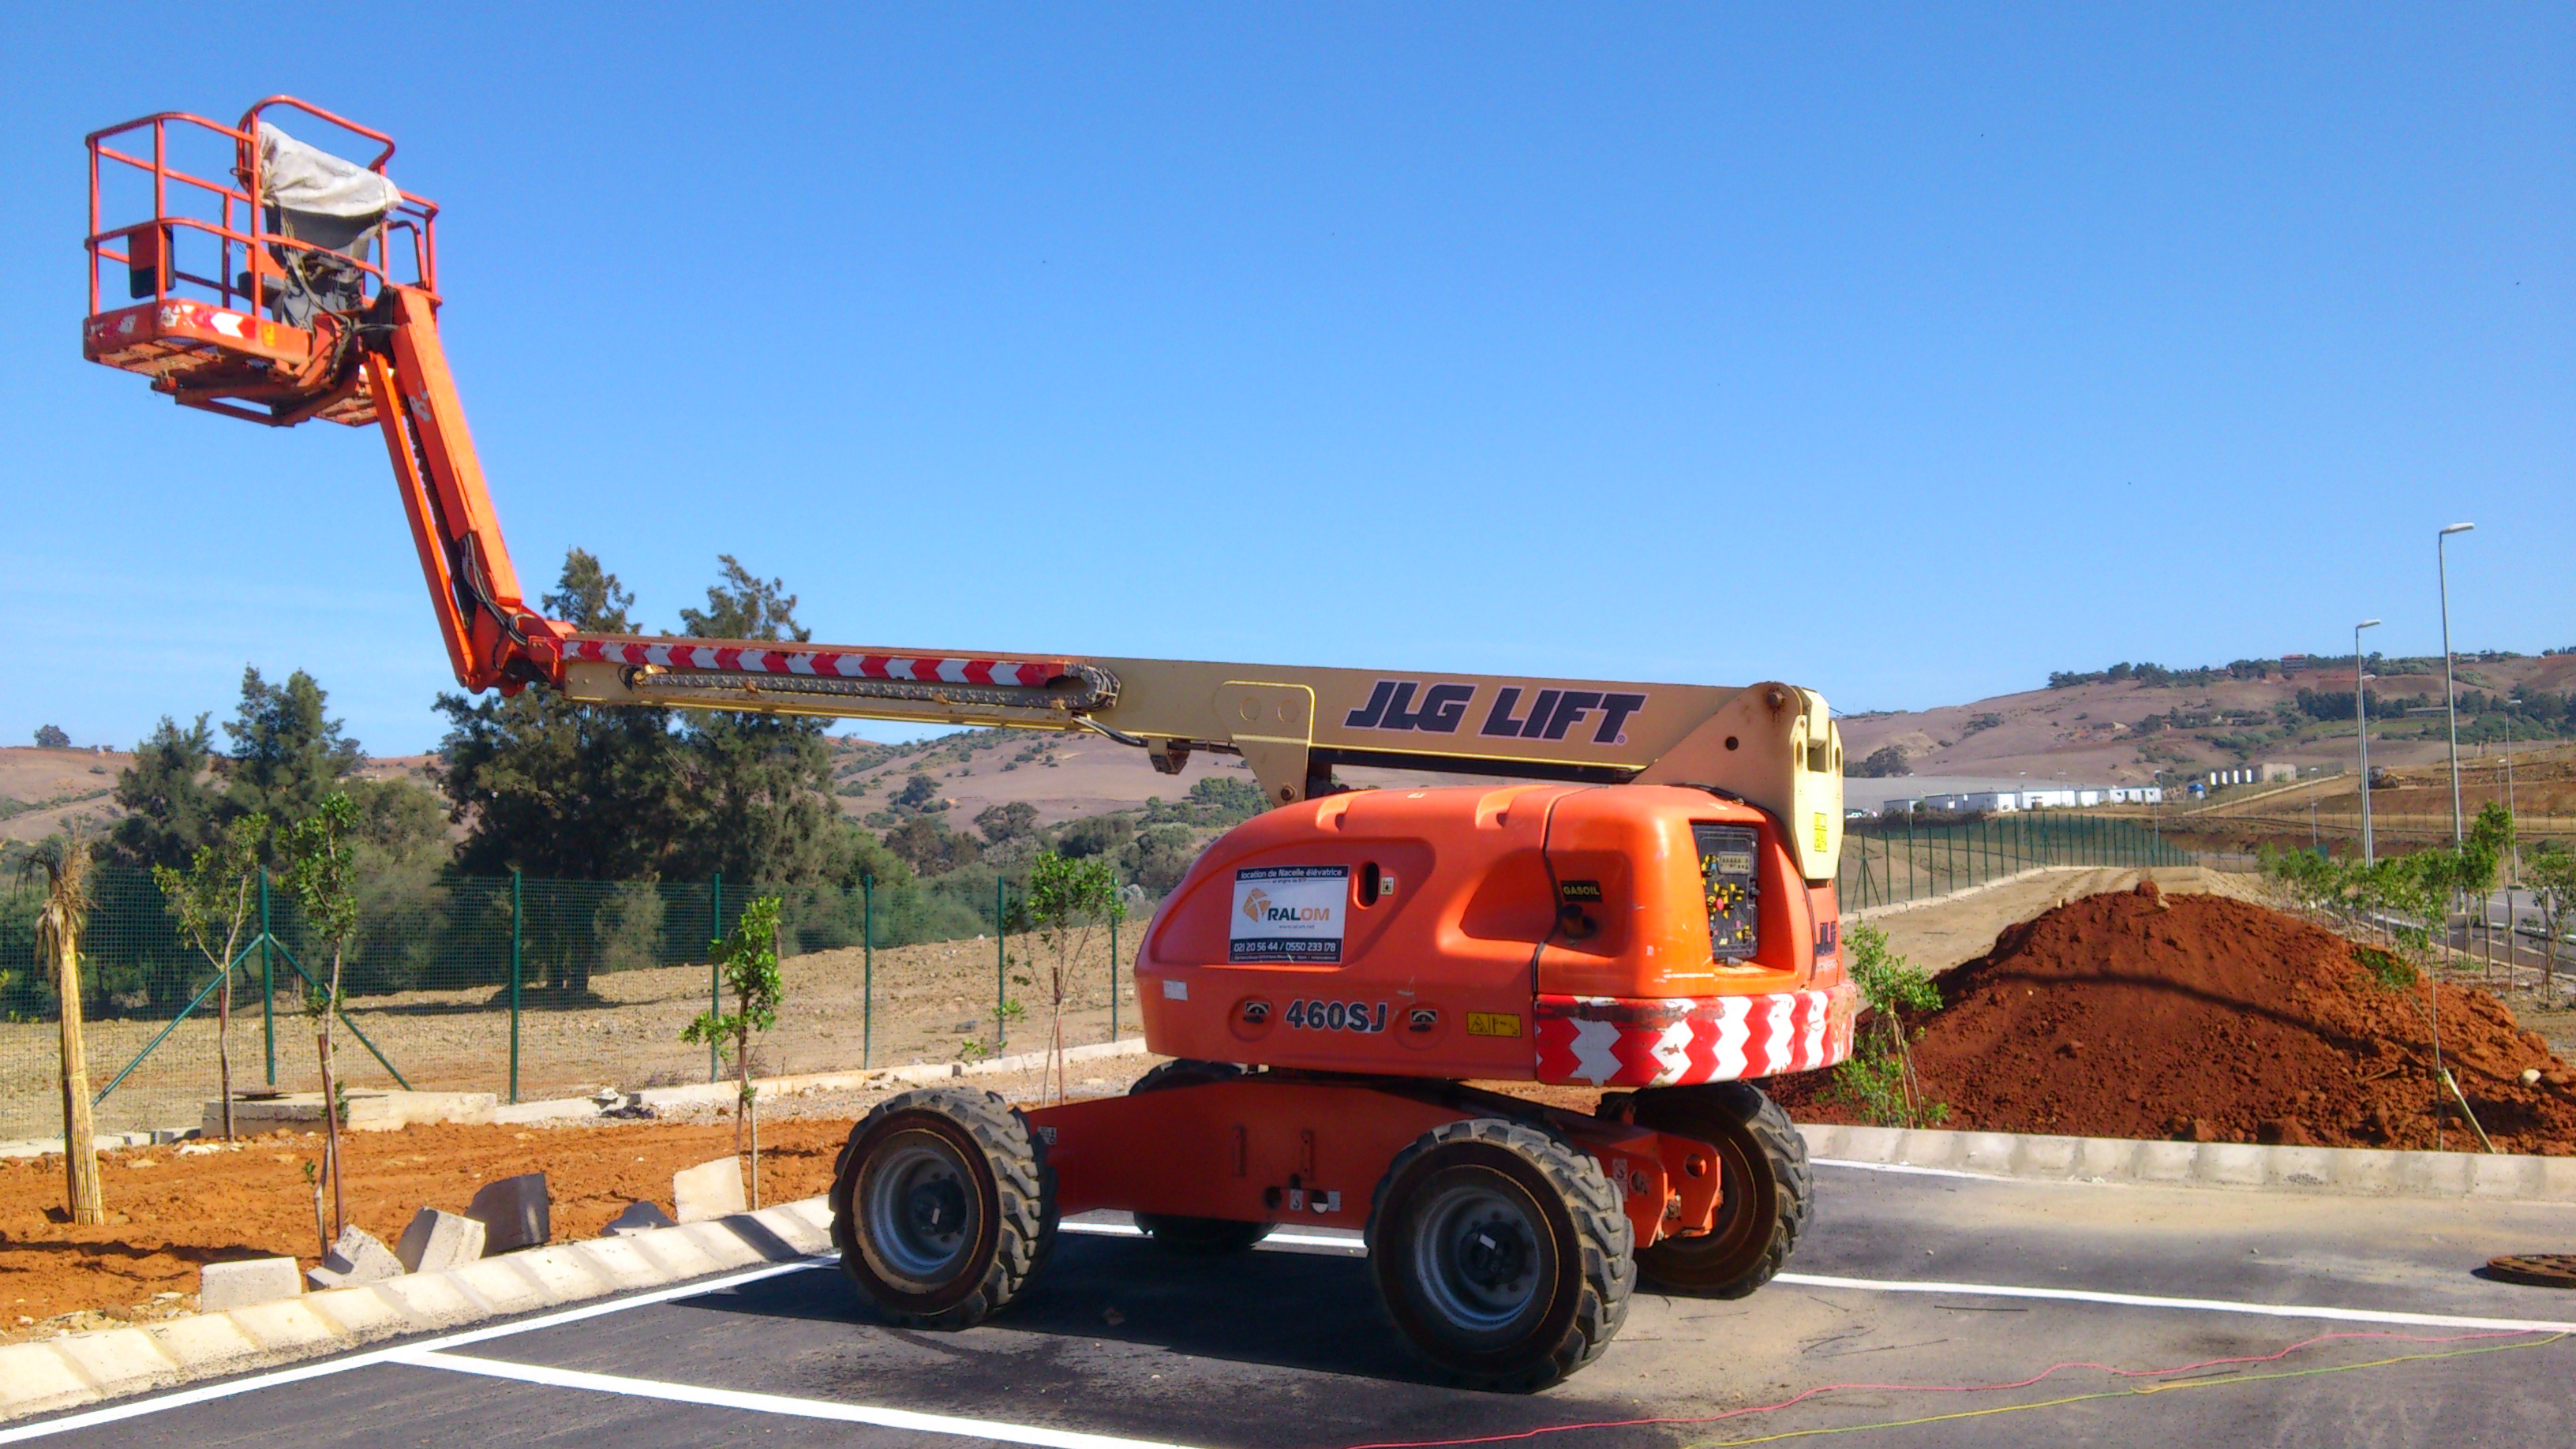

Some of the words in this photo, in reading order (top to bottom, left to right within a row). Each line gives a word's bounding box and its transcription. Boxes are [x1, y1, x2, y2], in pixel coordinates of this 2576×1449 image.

[1344, 680, 1477, 734] JLG
[1480, 687, 1647, 743] LIFT
[1241, 871, 1267, 879] location
[1563, 886, 1601, 896] GASOIL
[1267, 908, 1330, 921] RALOM
[1234, 943, 1245, 952] 021
[1245, 943, 1256, 952] 20
[1256, 942, 1267, 951] 56
[1267, 942, 1278, 951] 44
[1279, 942, 1284, 950] /
[1285, 942, 1306, 951] 0550
[1307, 942, 1323, 952] 233
[1324, 942, 1336, 952] 178
[1284, 998, 1388, 1033] 460SJ
